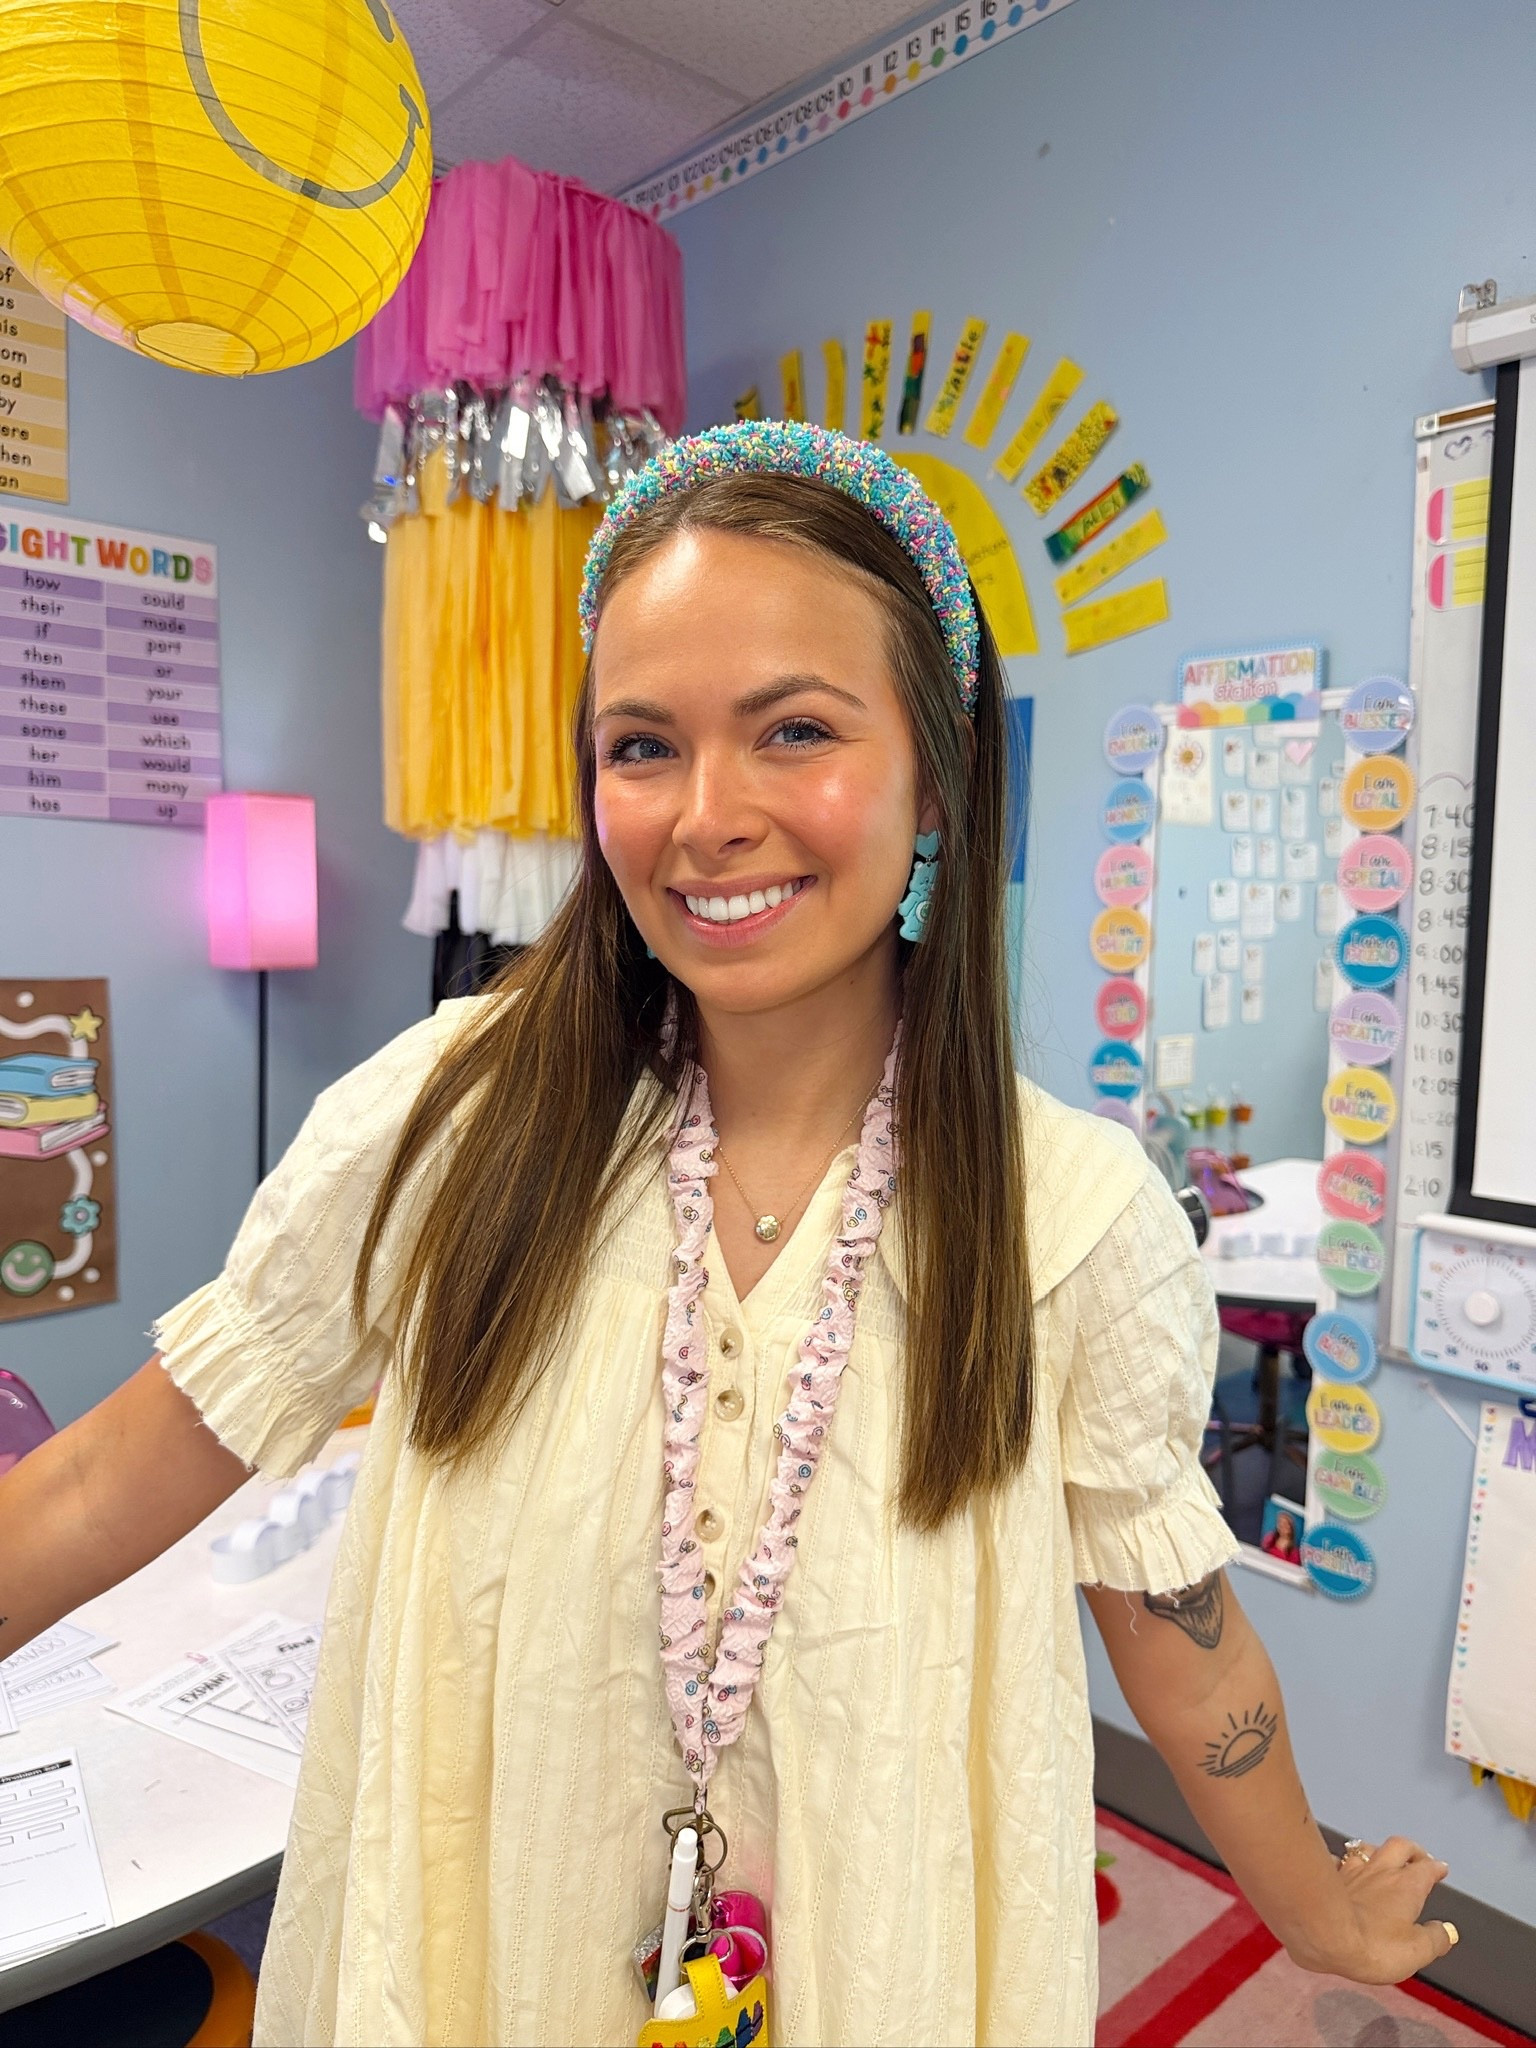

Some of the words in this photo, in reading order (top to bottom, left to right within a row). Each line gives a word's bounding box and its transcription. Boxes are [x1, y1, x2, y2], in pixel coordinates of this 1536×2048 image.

[97, 538, 214, 585] WORDS
[23, 569, 60, 591] how
[20, 596, 64, 616] their
[142, 592, 185, 611] could
[35, 622, 51, 639] if
[141, 616, 186, 634] made
[24, 646, 62, 665] then
[145, 639, 181, 656] part
[154, 665, 174, 678] or
[1184, 651, 1316, 686] AFFIRMATION
[21, 669, 66, 690] them
[146, 687, 183, 704] your
[1214, 679, 1278, 702] station
[20, 694, 67, 716] these
[21, 724, 67, 740] some
[141, 732, 191, 750] which
[30, 744, 60, 763] her
[142, 757, 191, 773] would
[28, 769, 61, 788] him
[146, 781, 189, 800] many
[1353, 789, 1400, 810] LOYAL
[30, 794, 61, 812] has
[156, 804, 178, 822] up
[1332, 1020, 1397, 1046] CREATIVE
[1329, 1096, 1390, 1123] UNIQUE
[1314, 1407, 1374, 1433] LEADER
